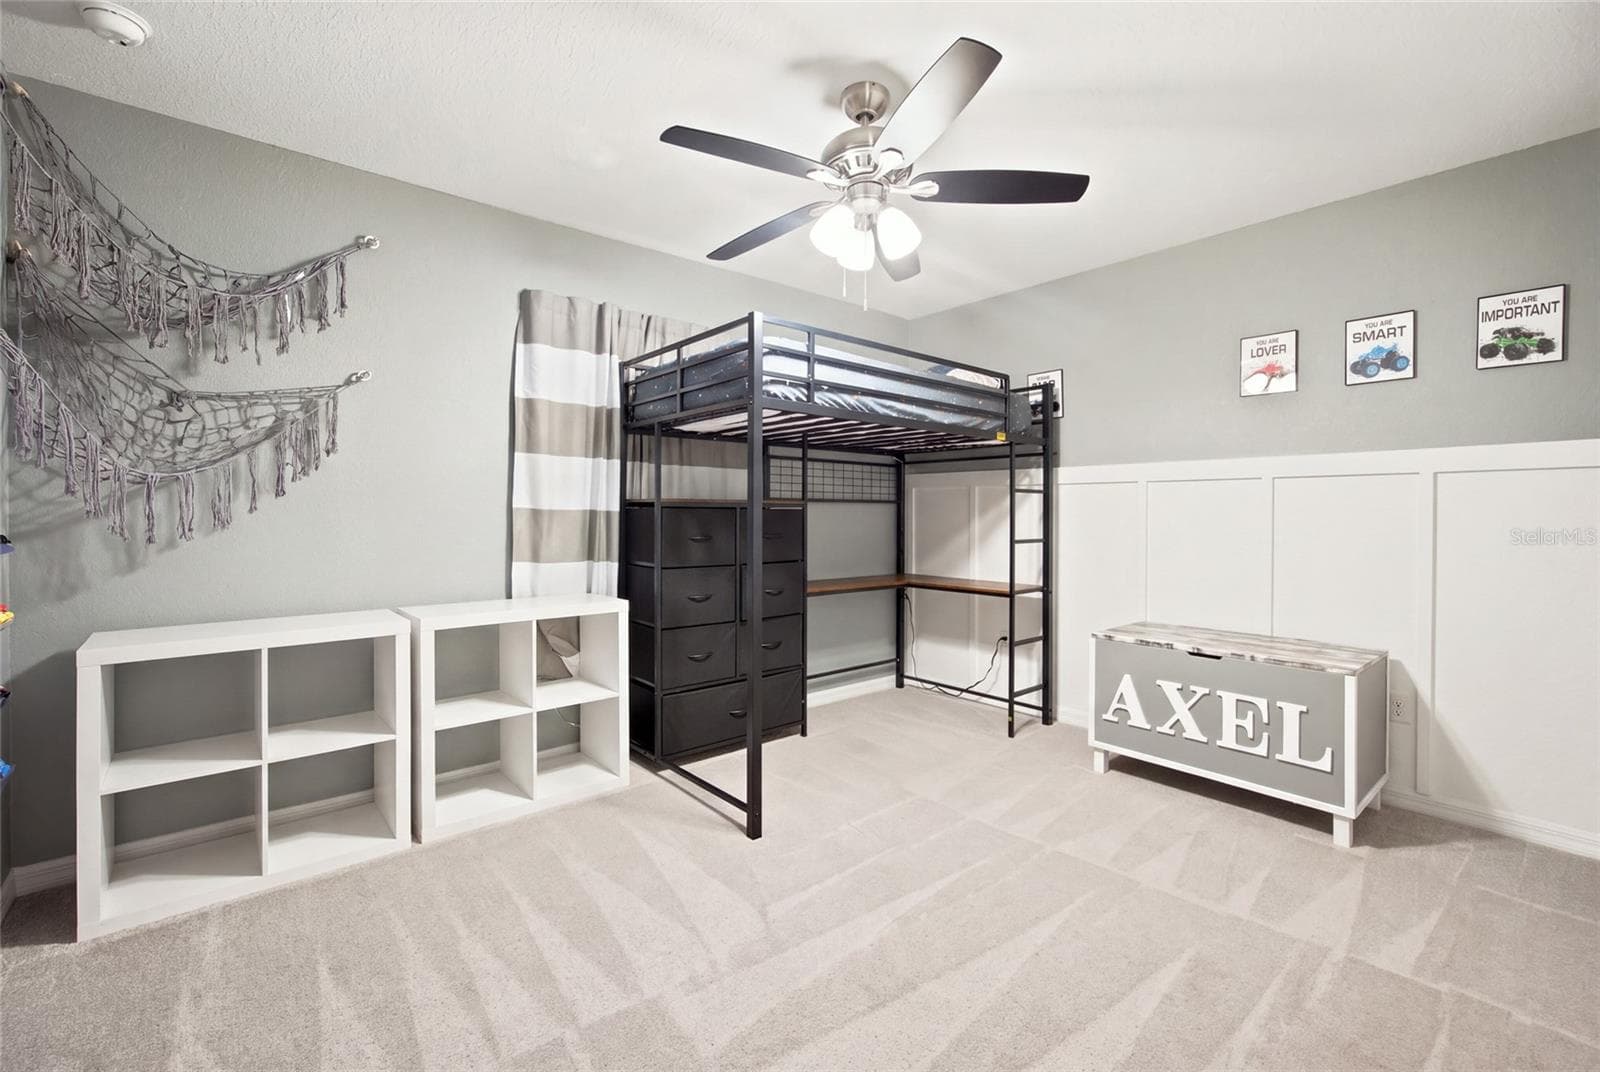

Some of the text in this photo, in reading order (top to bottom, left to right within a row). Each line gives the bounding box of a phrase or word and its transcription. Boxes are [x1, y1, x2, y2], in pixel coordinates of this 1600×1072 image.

[1502, 294, 1538, 306] YOU ARE
[1481, 300, 1560, 323] IMPORTANT
[1364, 319, 1393, 329] YOU ARE
[1352, 325, 1407, 343] SMART
[1250, 344, 1287, 358] LOVER
[1101, 673, 1333, 773] AXEL
